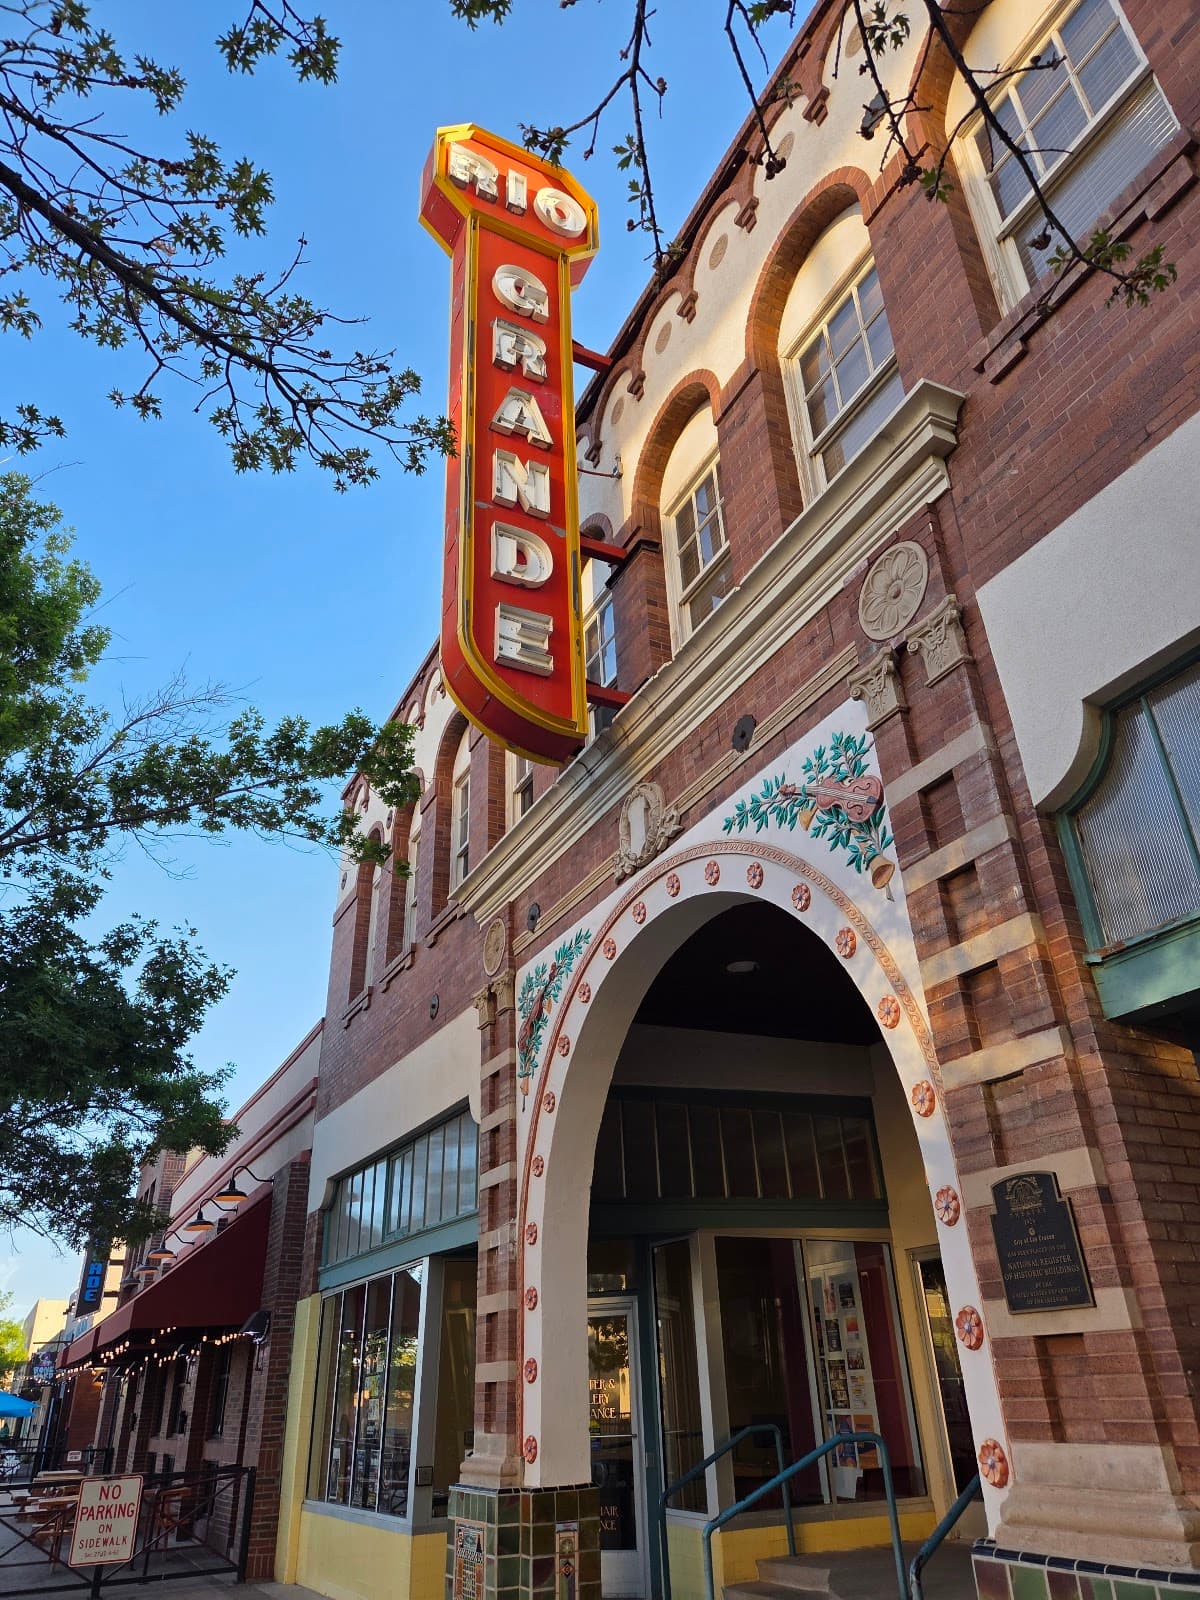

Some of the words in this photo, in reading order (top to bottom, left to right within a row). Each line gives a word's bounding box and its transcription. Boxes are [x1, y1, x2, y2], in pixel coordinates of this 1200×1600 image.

[449, 142, 587, 238] RIO
[488, 264, 555, 677] GRANDE
[1008, 1258, 1040, 1270] NATIONAL
[1040, 1255, 1072, 1266] REGISTER
[1014, 1269, 1043, 1280] HISTORIC
[1044, 1265, 1080, 1276] BUILDINGS
[608, 1378, 616, 1389] &
[99, 1484, 122, 1500] NO
[80, 1502, 135, 1521] PARKING
[98, 1523, 113, 1534] ON
[79, 1535, 128, 1549] SIDEWALK
